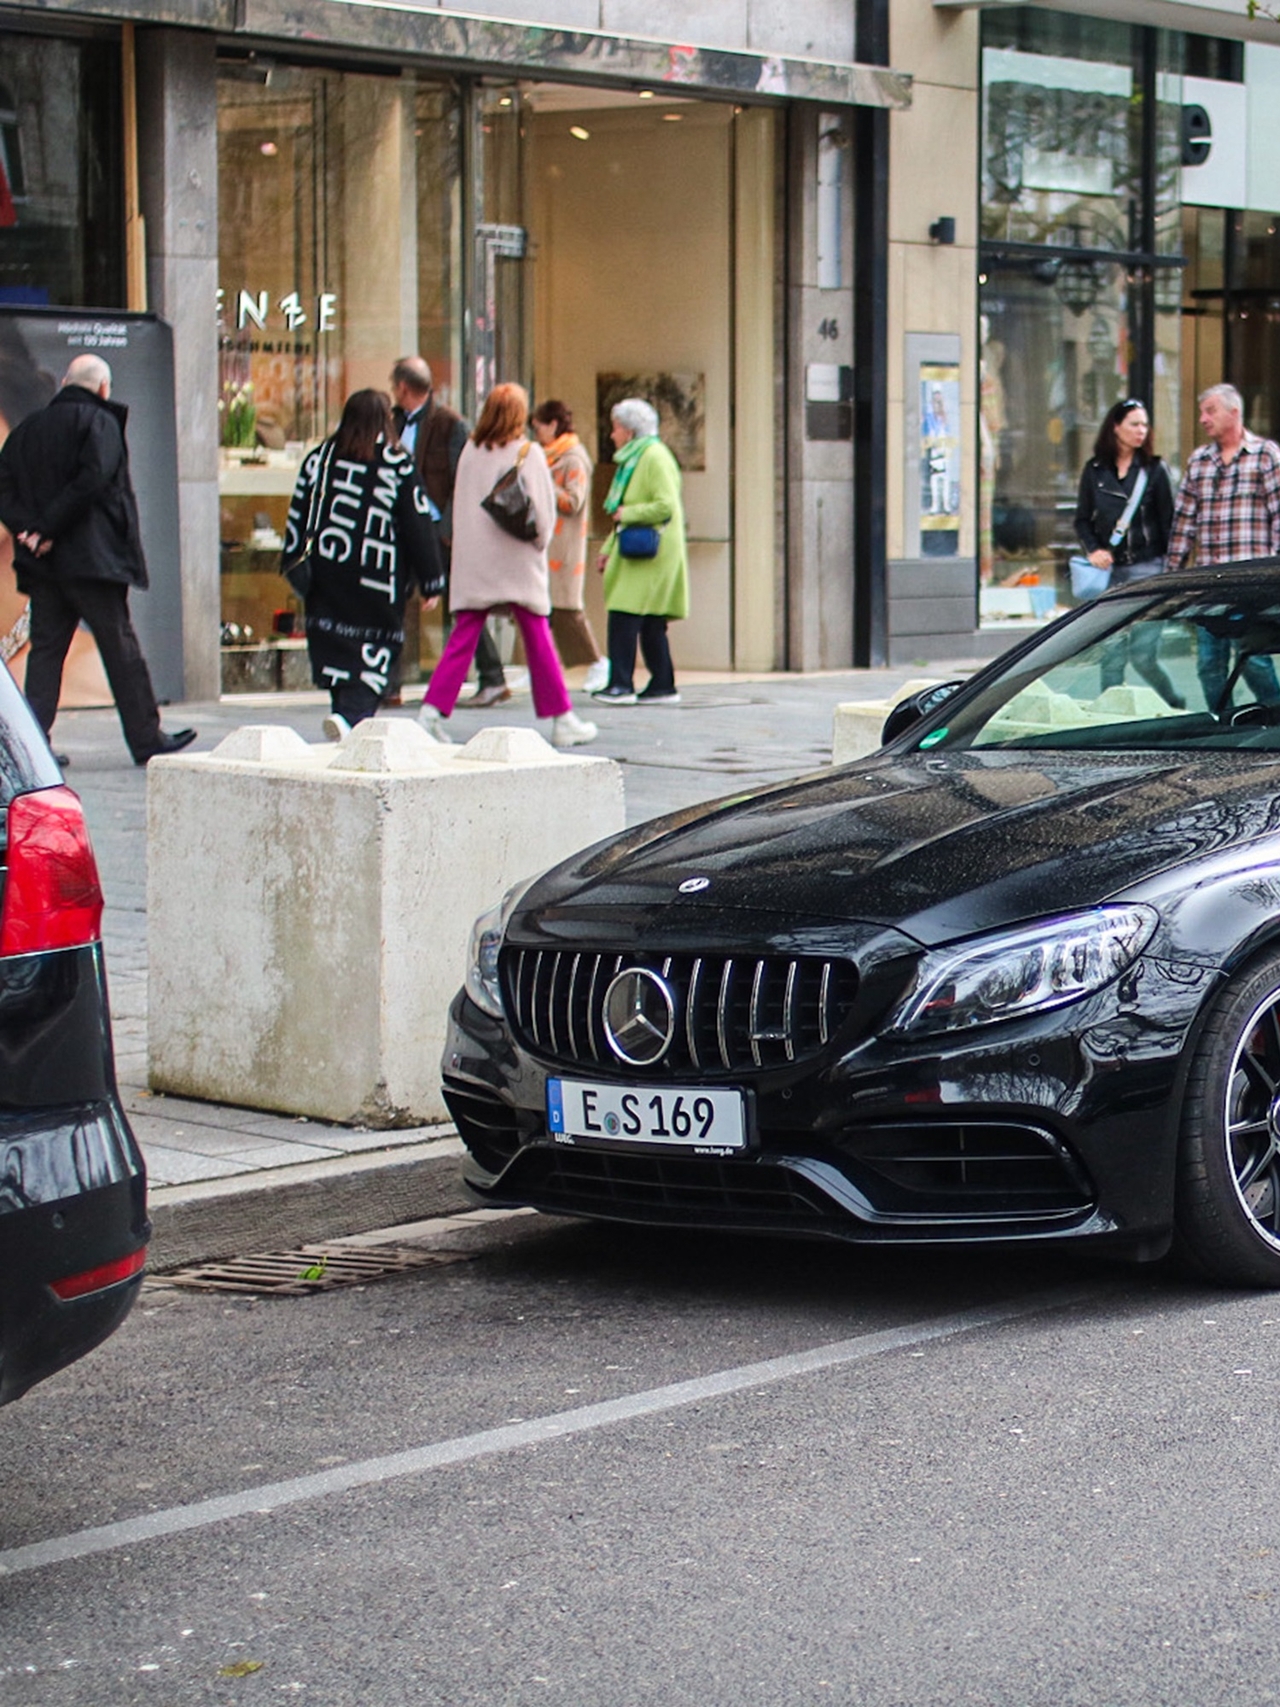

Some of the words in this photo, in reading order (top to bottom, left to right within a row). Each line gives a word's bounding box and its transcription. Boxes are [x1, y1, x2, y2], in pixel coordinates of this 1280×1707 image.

[817, 318, 839, 340] 46
[319, 459, 367, 563] HUG
[360, 445, 414, 604] SWEET
[552, 1111, 561, 1123] D
[582, 1090, 602, 1132] E
